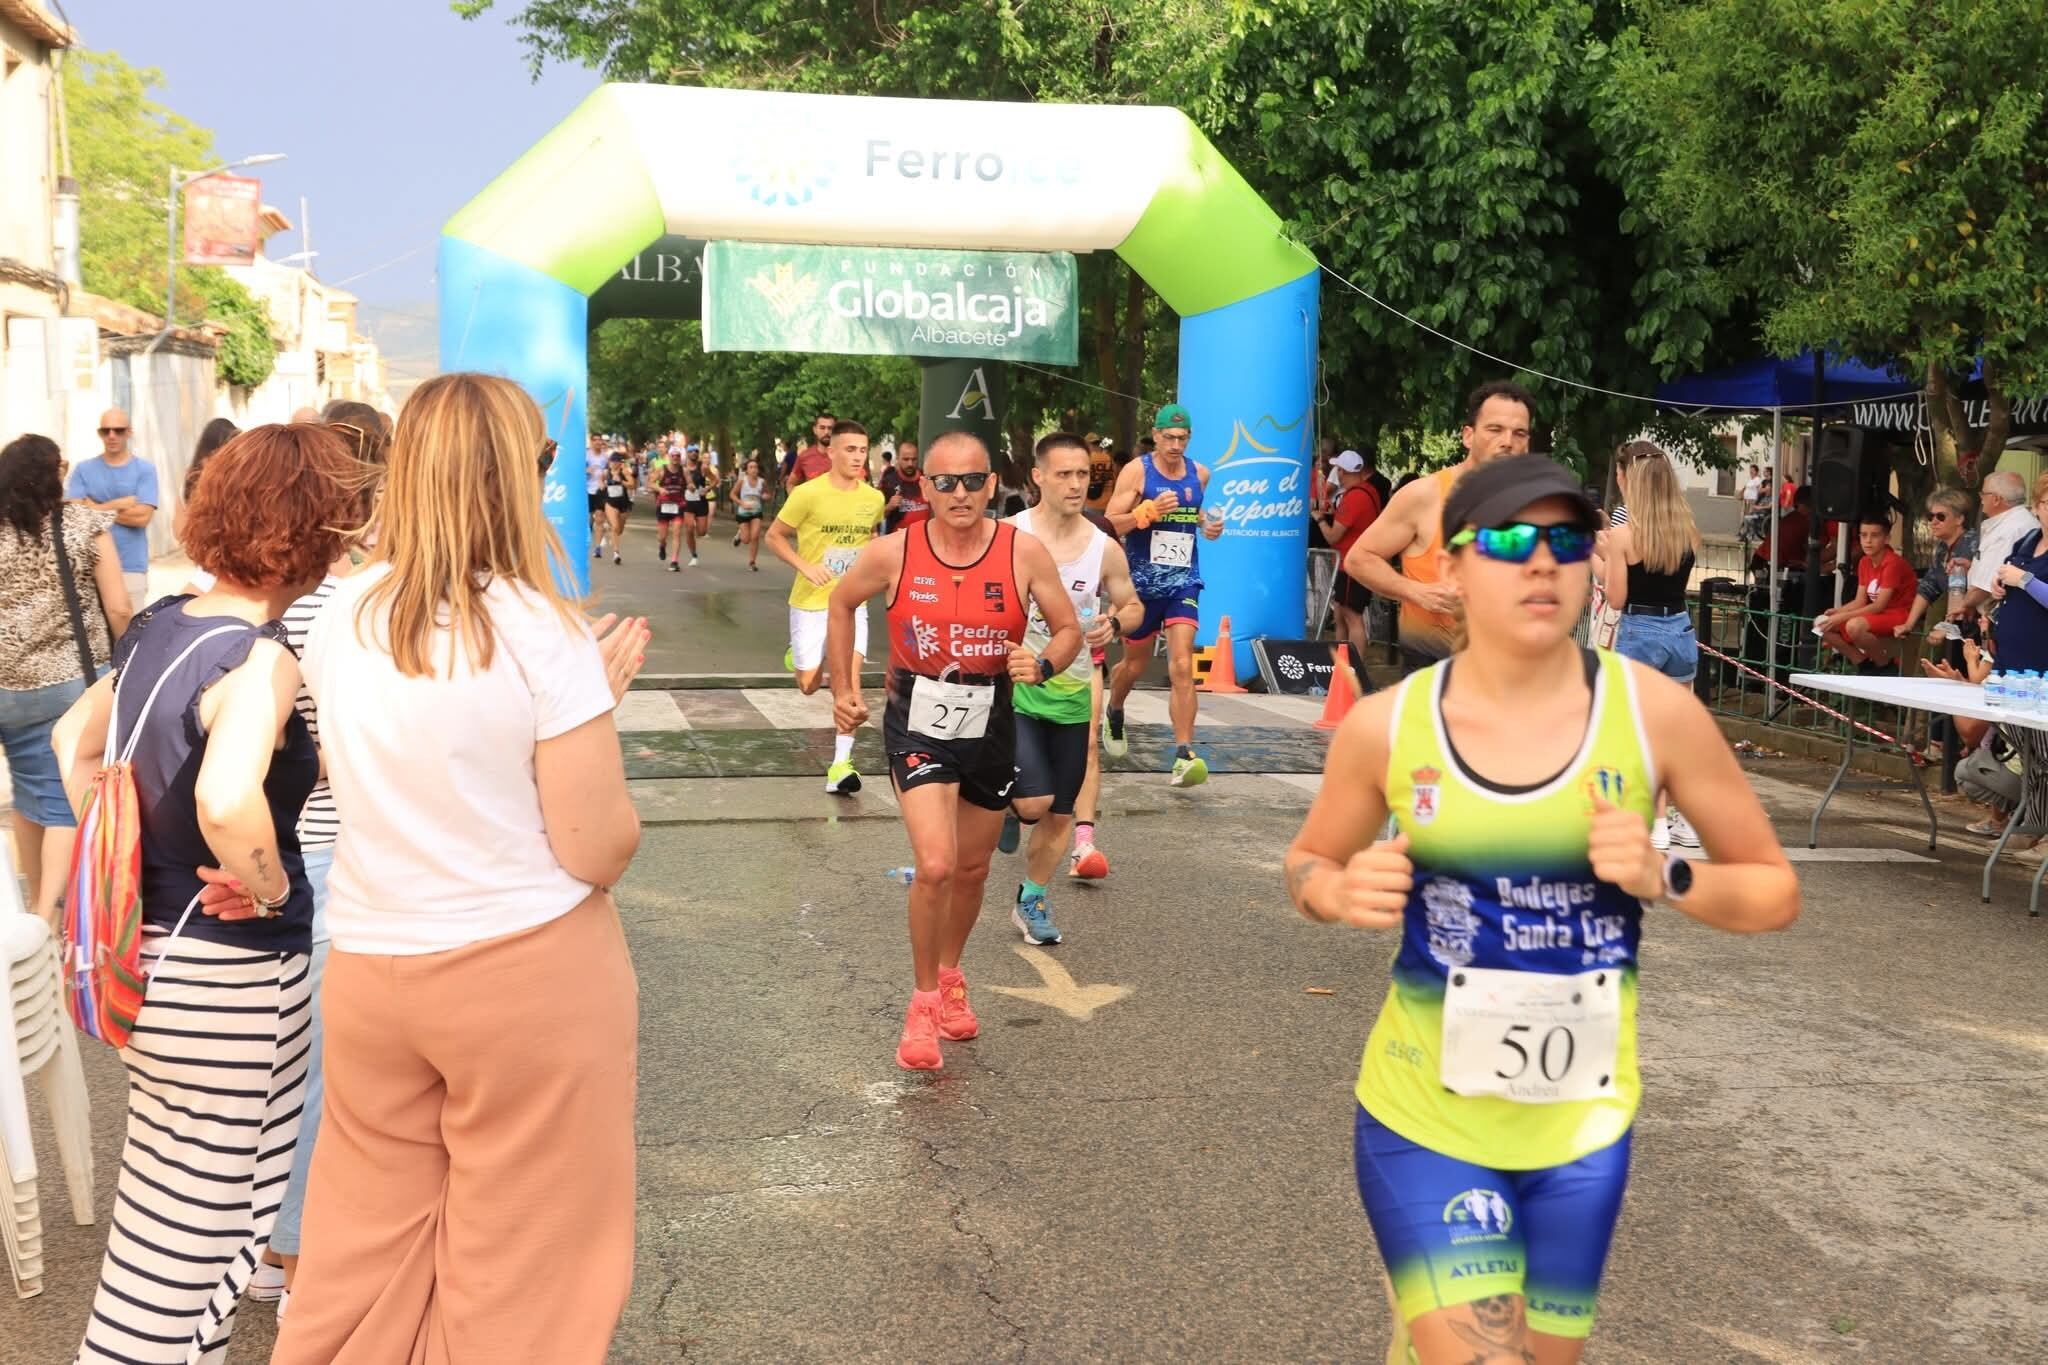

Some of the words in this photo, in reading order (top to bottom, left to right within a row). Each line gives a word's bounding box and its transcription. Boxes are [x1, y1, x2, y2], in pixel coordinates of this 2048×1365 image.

[841, 260, 1041, 281] FUNDACIÓN
[828, 279, 1048, 337] Globalcaja
[911, 325, 1007, 347] Albacete
[1223, 479, 1269, 496] con
[1279, 466, 1300, 492] el
[1157, 543, 1188, 562] 258
[949, 623, 1009, 640] Pedro
[930, 703, 970, 732] 27
[1496, 875, 1596, 917] Bodegas
[1502, 914, 1574, 951] Santa
[1580, 909, 1625, 947] Cruz
[1495, 1025, 1575, 1082] 50
[1504, 1082, 1560, 1098] Andrea
